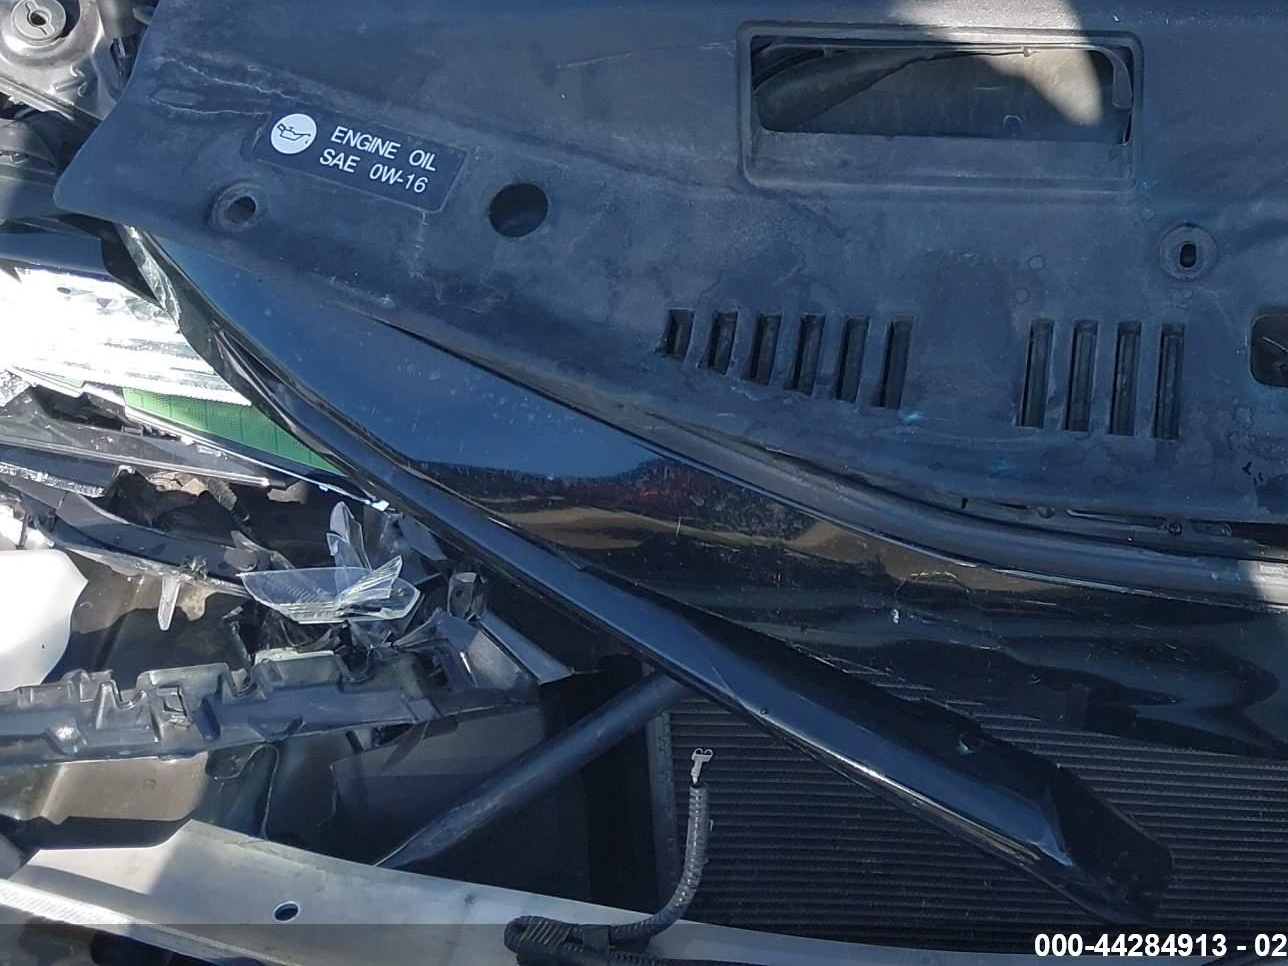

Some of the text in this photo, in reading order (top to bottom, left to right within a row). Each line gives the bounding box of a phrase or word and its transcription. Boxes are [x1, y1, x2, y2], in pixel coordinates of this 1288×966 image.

[319, 148, 429, 193] SAE 0W-16
[330, 125, 437, 172] ENGINE OIL
